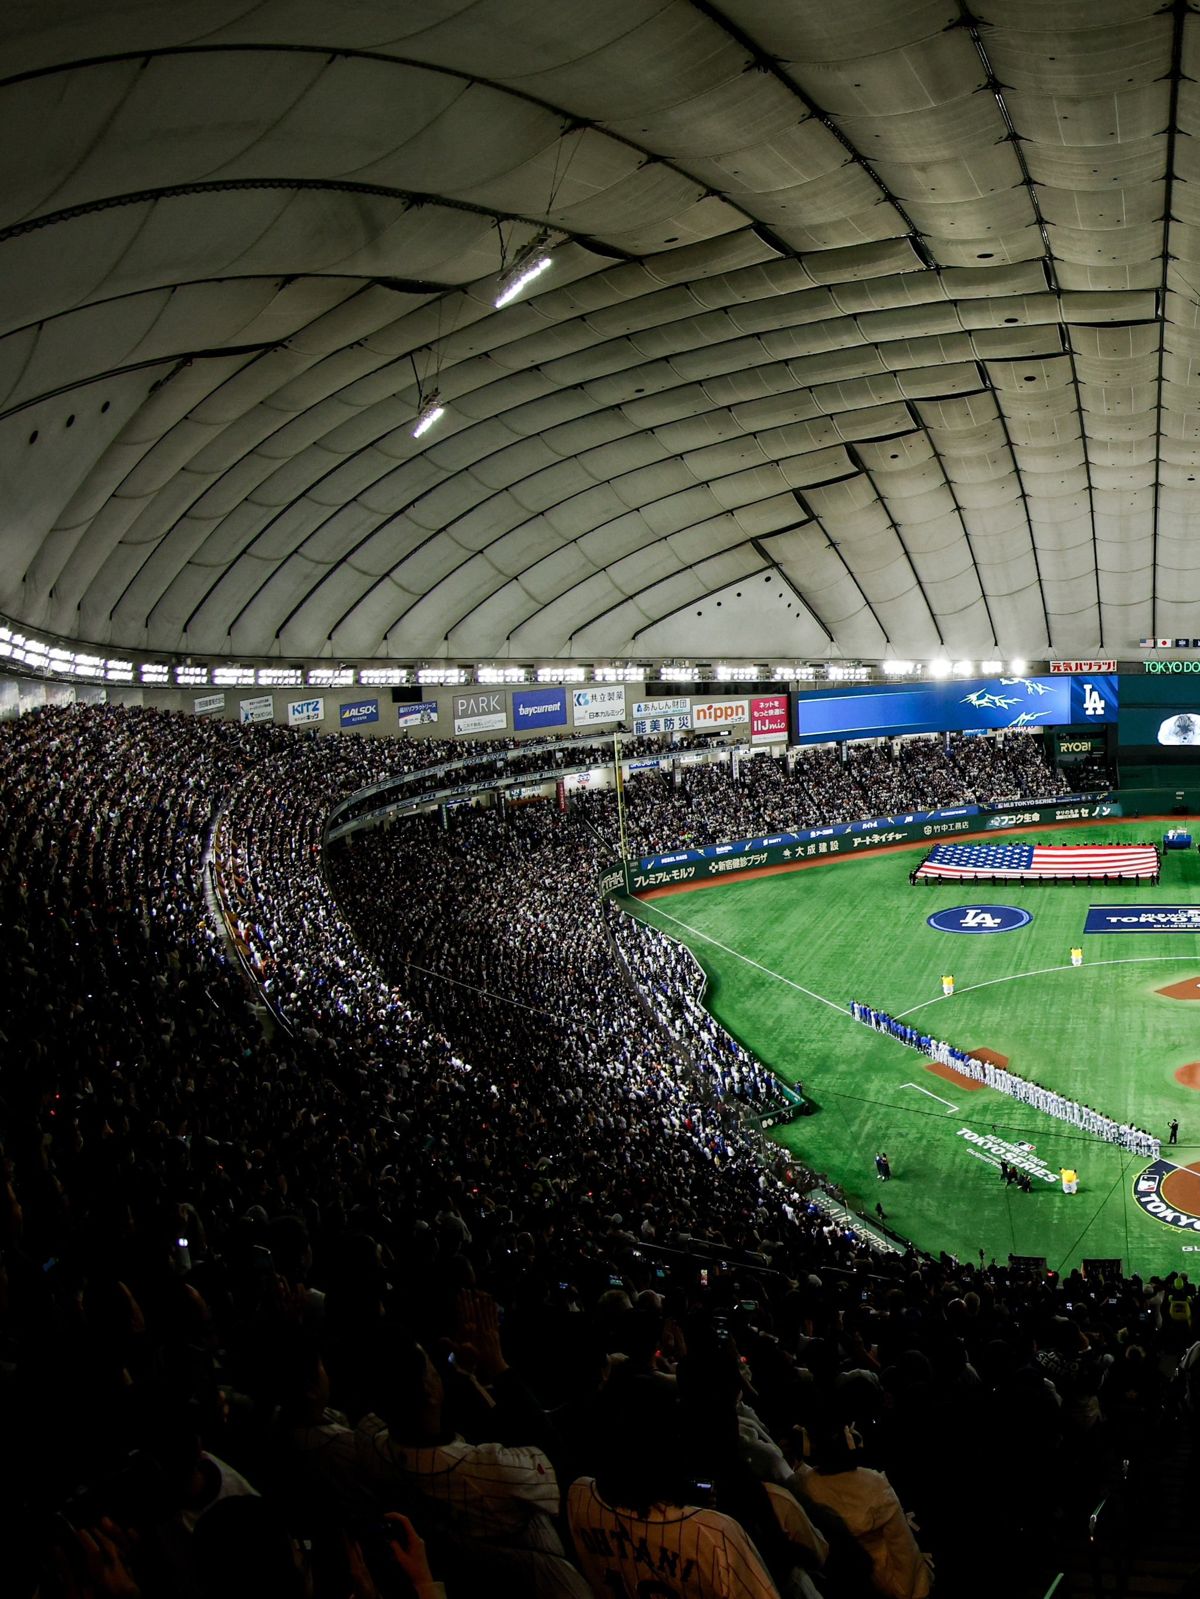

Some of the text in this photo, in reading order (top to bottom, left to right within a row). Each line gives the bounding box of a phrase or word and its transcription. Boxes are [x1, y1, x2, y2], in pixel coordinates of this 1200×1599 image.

[1051, 661, 1116, 672] 元気ハツラツ!
[1143, 661, 1182, 673] TOKYO
[292, 701, 319, 716] KITZ
[348, 705, 376, 717] ALSOK
[458, 695, 500, 715] PARK
[518, 702, 561, 716] baycurrent
[643, 700, 687, 712] あんしん財団
[696, 704, 745, 721] nippn
[635, 716, 689, 734] 能美防災
[1060, 742, 1091, 752] RYOBI
[1000, 813, 1040, 826] フコク生命
[933, 821, 969, 833] 竹中工務店
[853, 832, 908, 847] アートネイチャー
[795, 840, 839, 857] 大成建設
[959, 910, 1001, 927] LA
[956, 1127, 1006, 1155] TOKYO
[1001, 1152, 1060, 1183] SERIES
